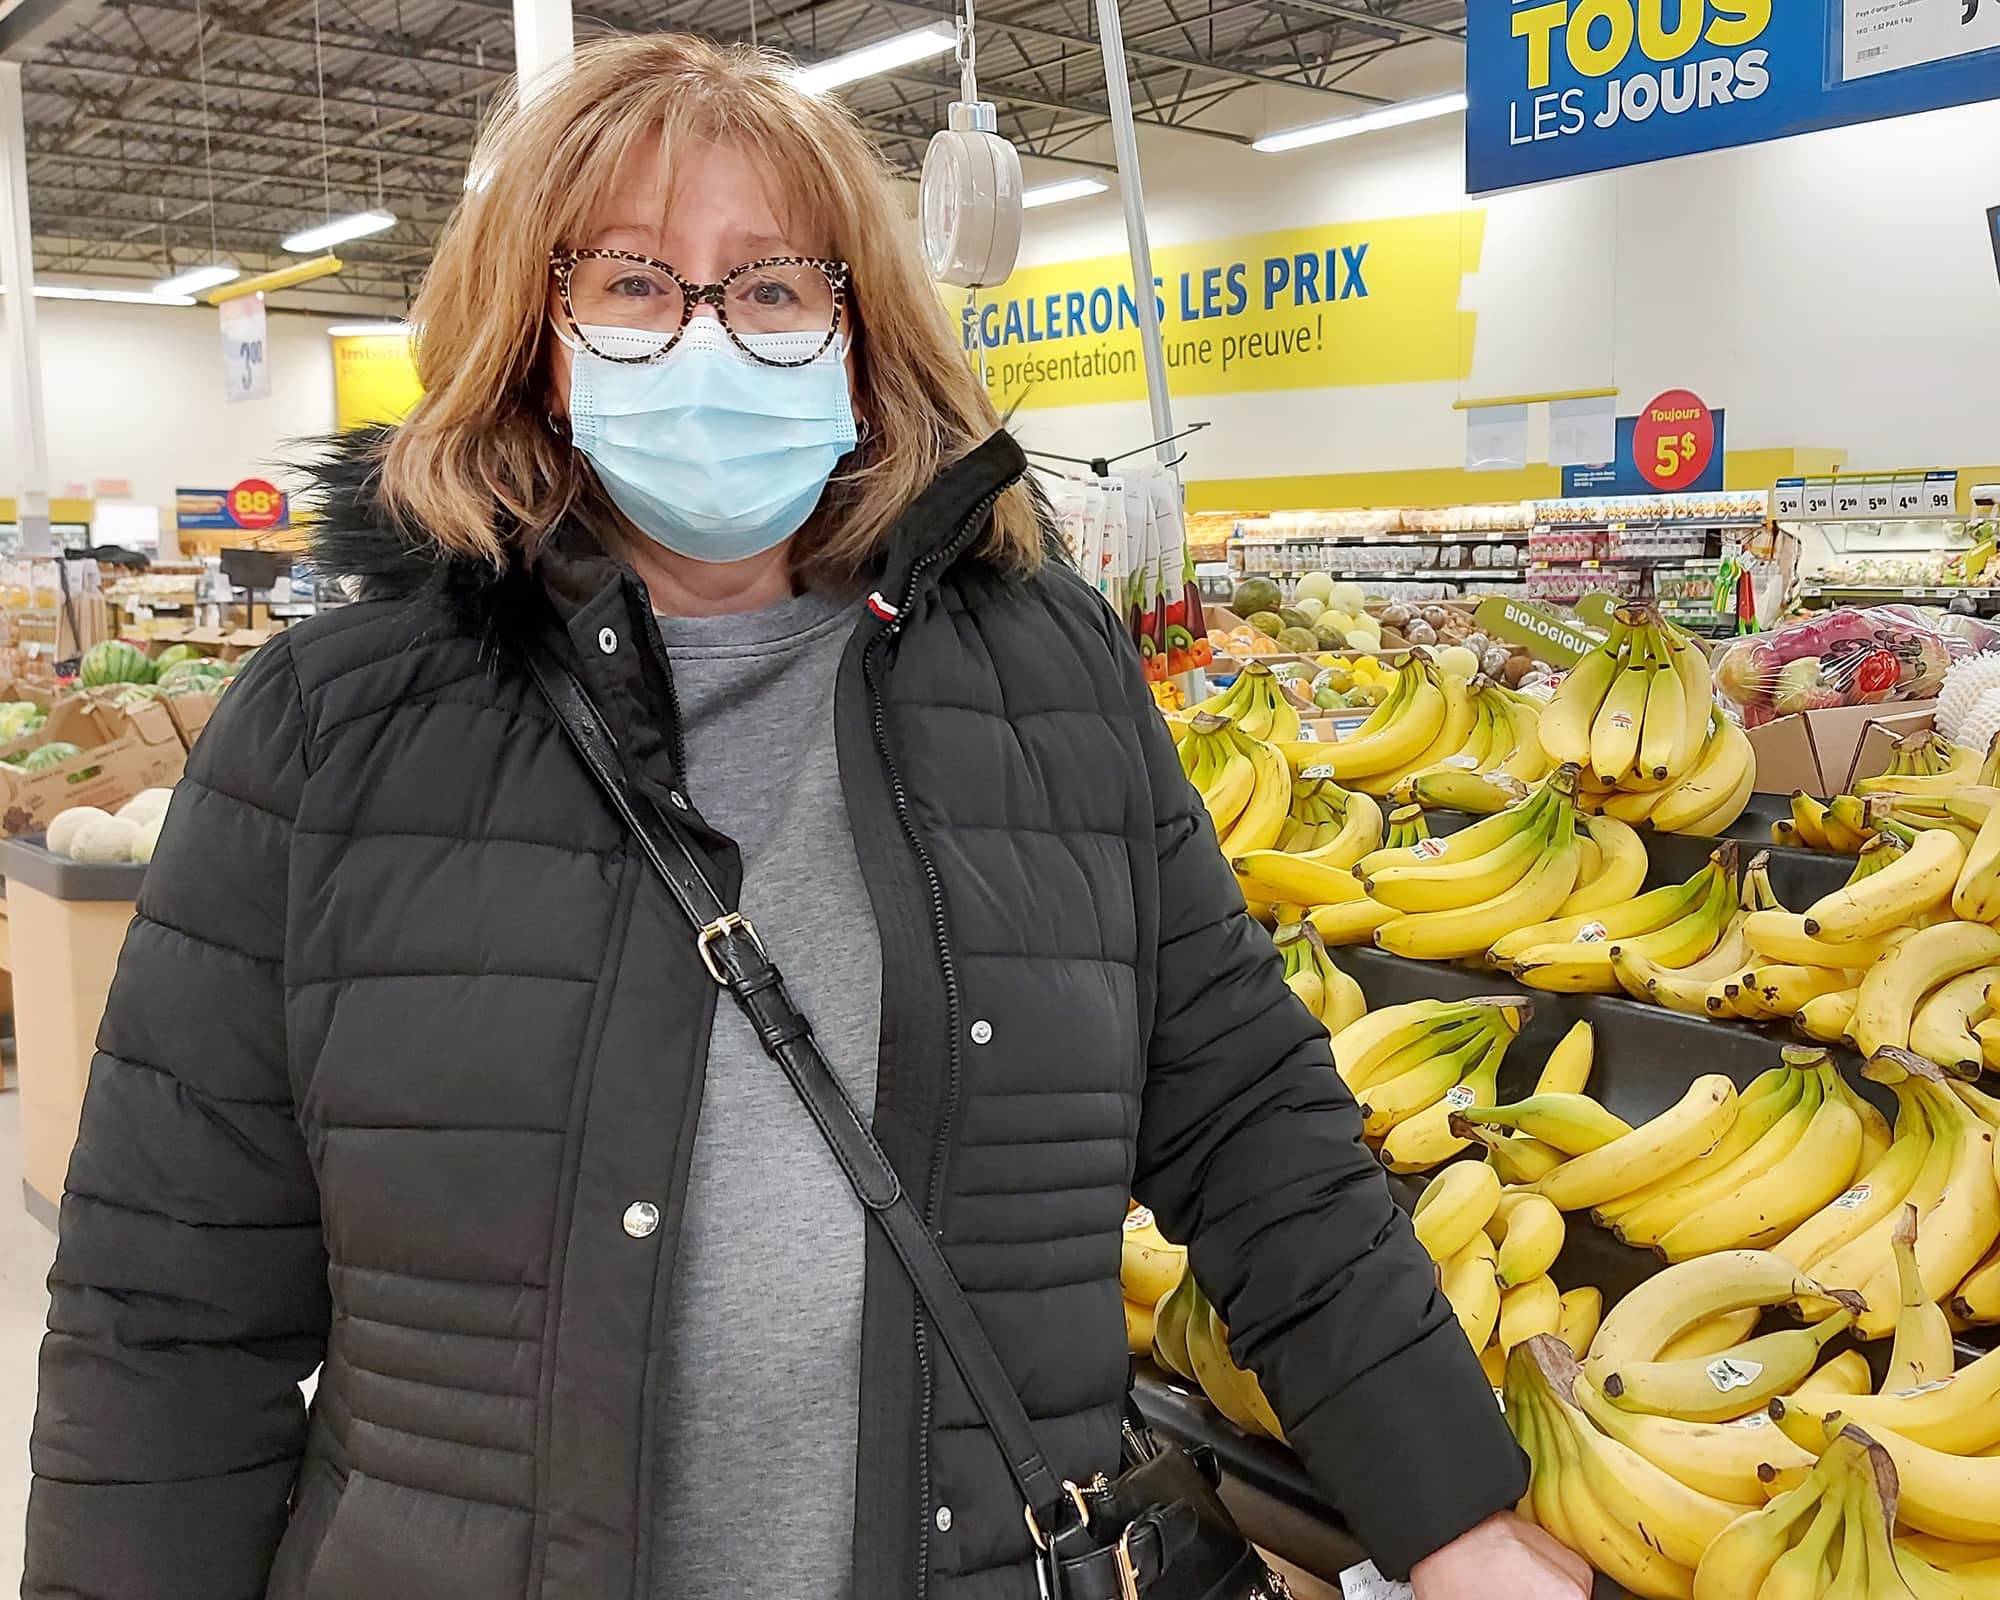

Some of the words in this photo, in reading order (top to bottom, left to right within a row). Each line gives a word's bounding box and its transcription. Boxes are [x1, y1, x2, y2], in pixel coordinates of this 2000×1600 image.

[1511, 0, 1772, 90] TOUS
[1510, 88, 1585, 146] LES
[1593, 49, 1770, 128] JOURS
[1180, 262, 1248, 322] LES
[1264, 243, 1369, 311] PRIX
[1003, 342, 1136, 395] présentation
[1651, 407, 1701, 423] Toujours
